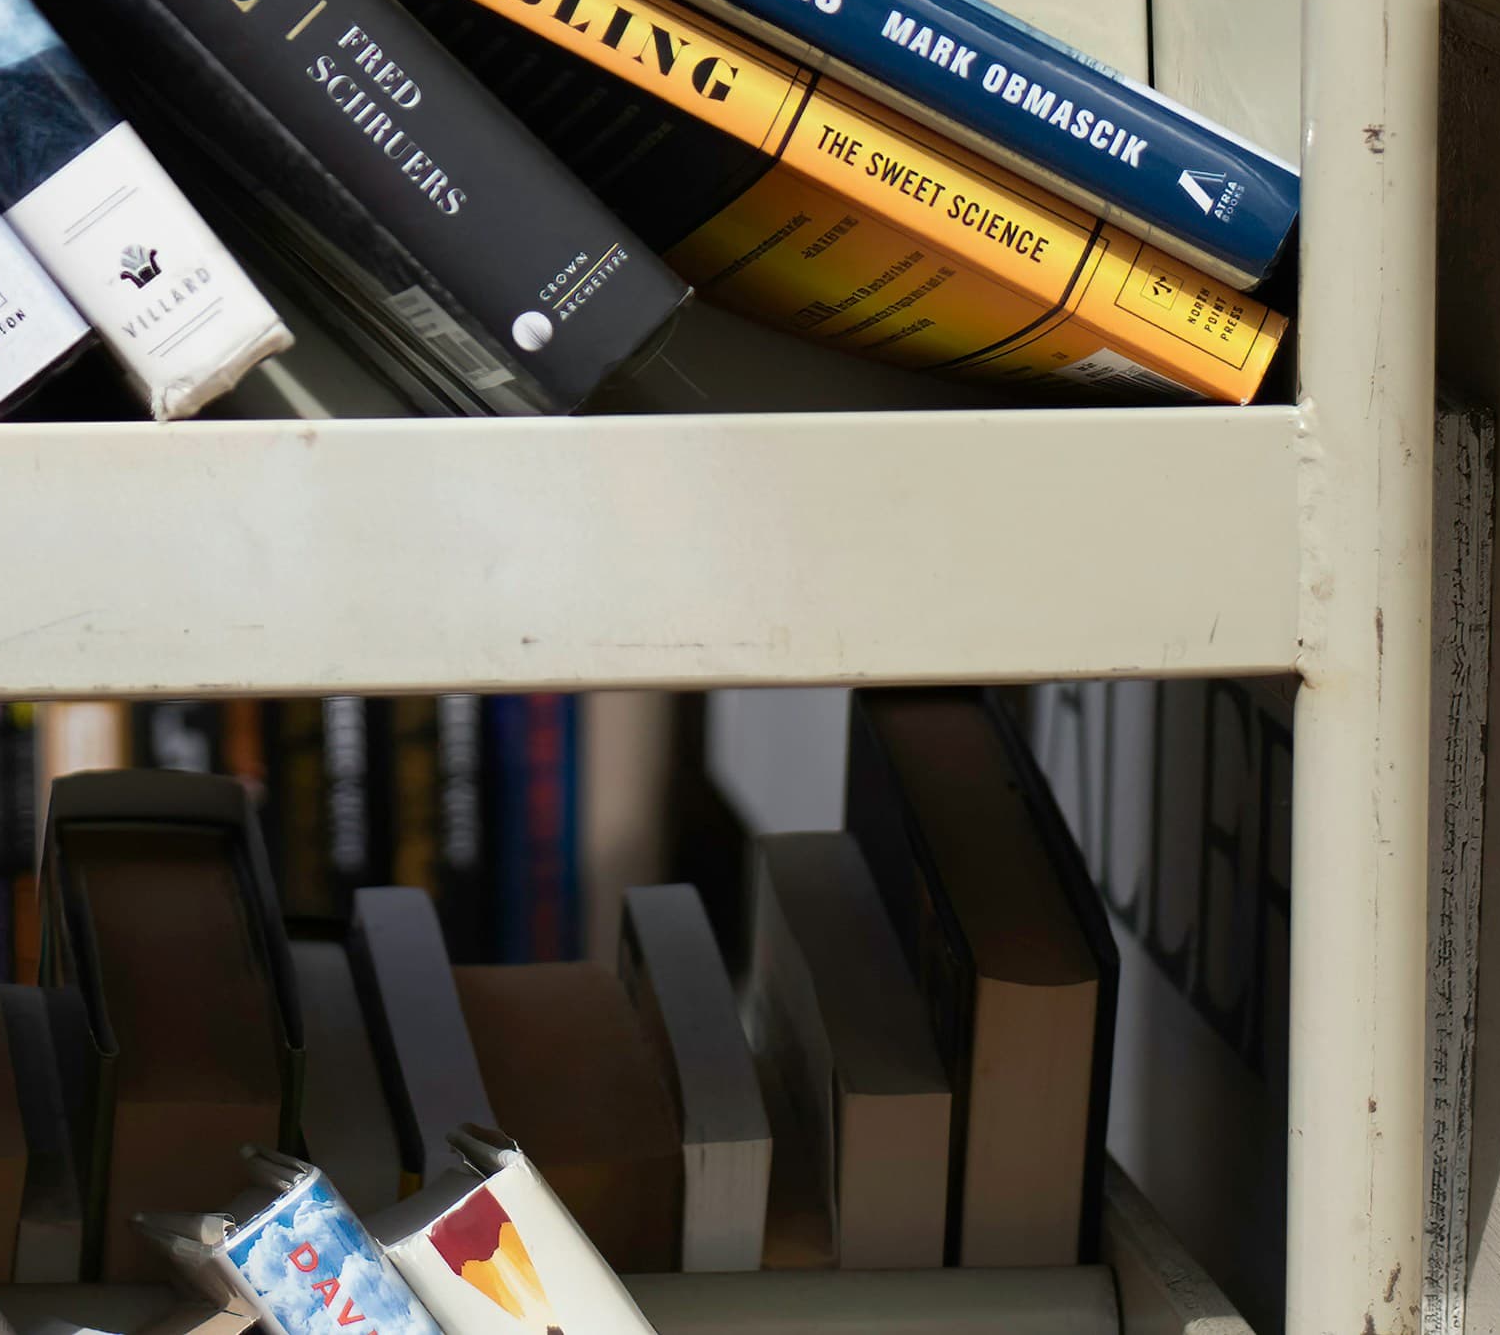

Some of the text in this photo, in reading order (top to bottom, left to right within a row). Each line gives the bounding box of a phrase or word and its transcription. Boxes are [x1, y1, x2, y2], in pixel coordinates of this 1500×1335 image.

[336, 25, 422, 110] FRED
[880, 9, 1149, 168] MARK OBMASCIK
[817, 124, 1050, 264] THE SWEET SCIENCE
